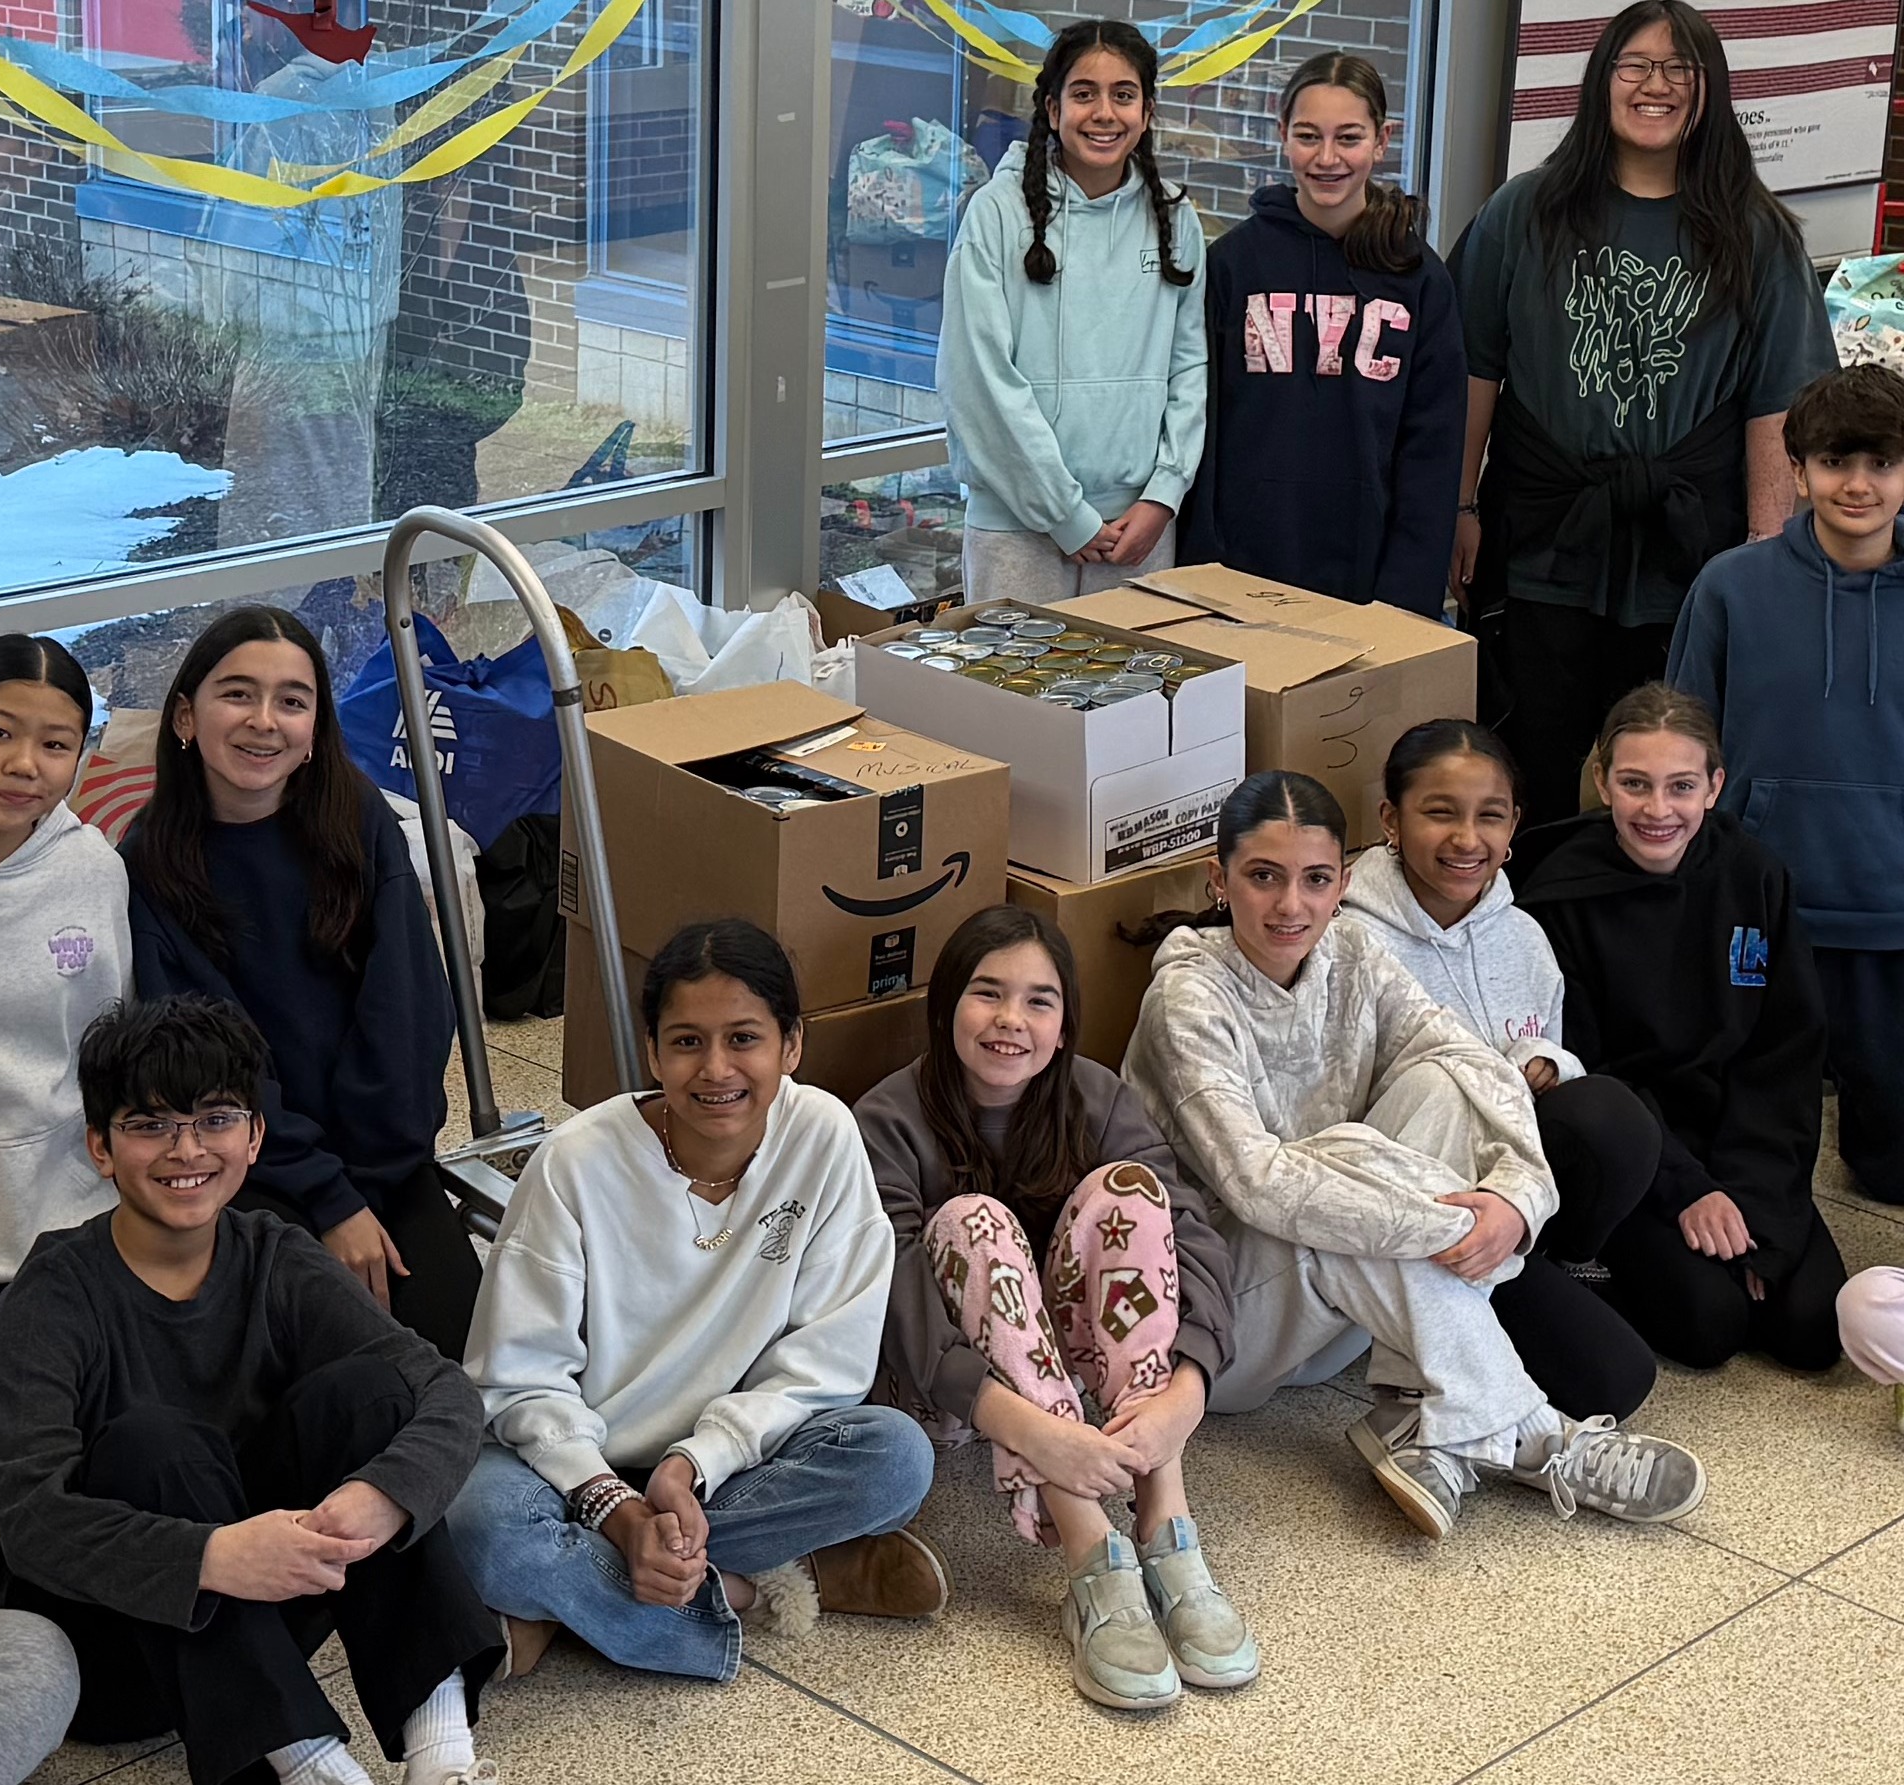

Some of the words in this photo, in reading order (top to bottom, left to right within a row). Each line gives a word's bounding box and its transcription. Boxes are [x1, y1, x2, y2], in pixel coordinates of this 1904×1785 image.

[1244, 292, 1411, 382] NYC
[390, 745, 455, 775] ADI
[1174, 809, 1199, 825] COPY
[1200, 798, 1226, 817] PAP
[758, 1199, 806, 1229] TEXAS
